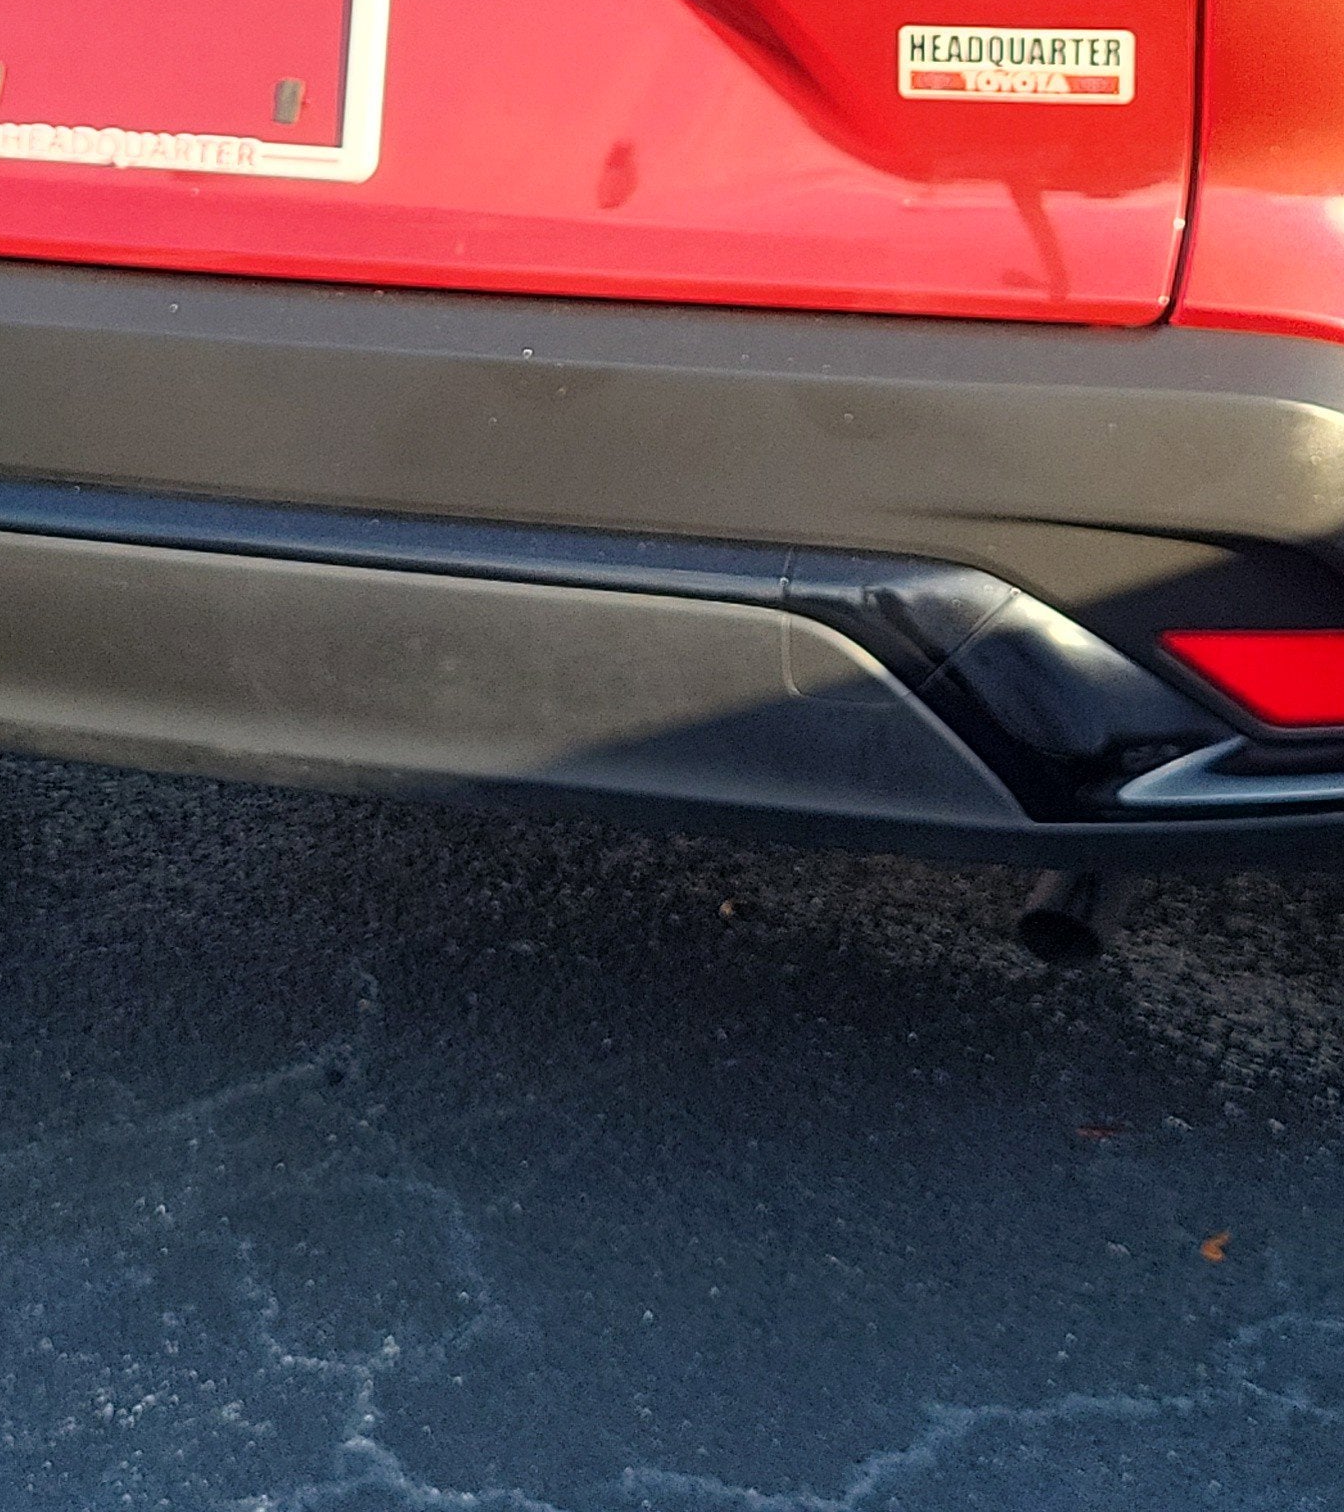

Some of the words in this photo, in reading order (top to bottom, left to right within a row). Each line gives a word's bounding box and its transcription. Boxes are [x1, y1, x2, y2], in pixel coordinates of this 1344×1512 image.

[909, 34, 1121, 68] HEADQUARTER
[961, 69, 1071, 94] TOYOTA
[1, 124, 257, 168] HEADQUARTER
